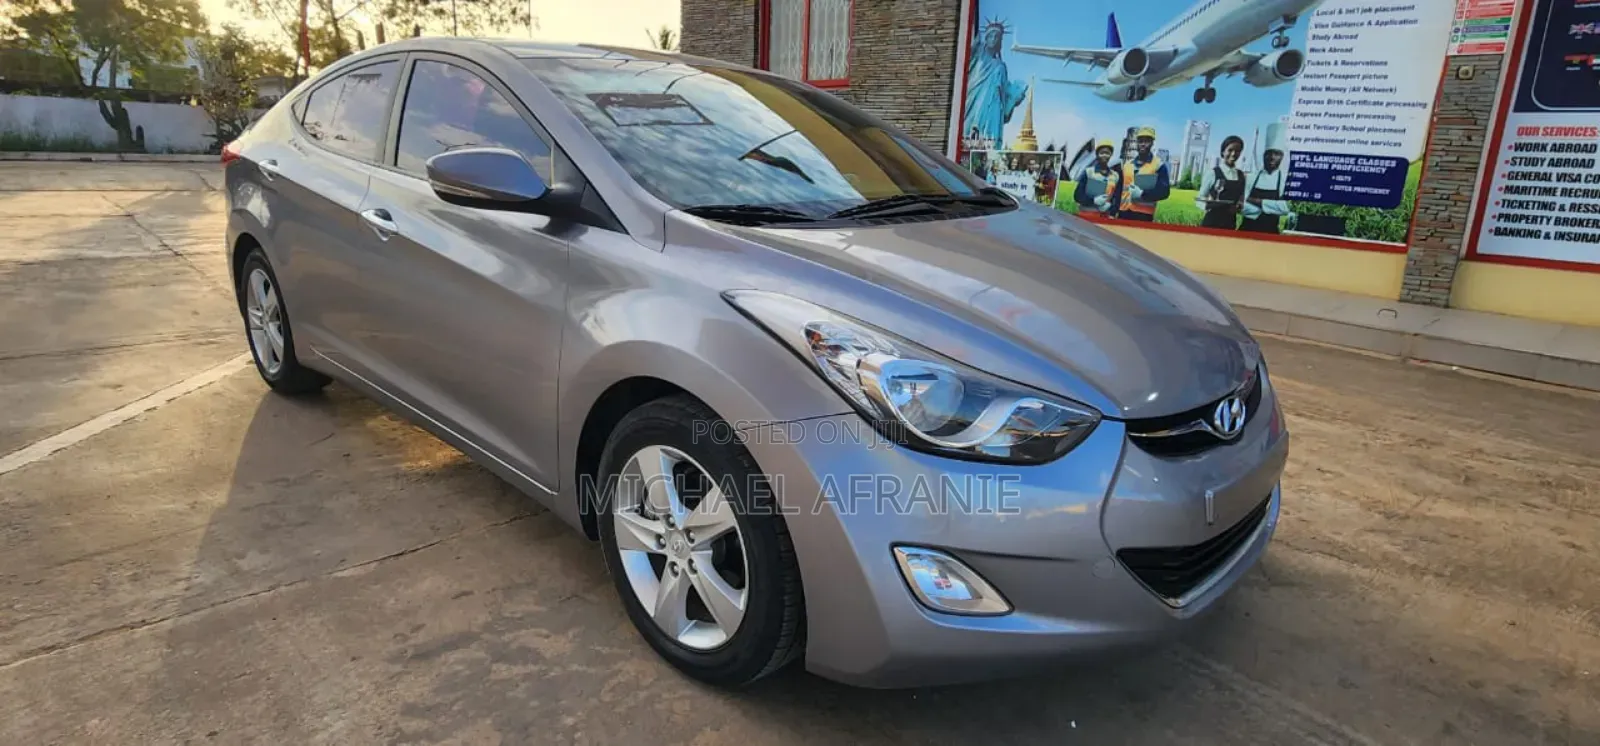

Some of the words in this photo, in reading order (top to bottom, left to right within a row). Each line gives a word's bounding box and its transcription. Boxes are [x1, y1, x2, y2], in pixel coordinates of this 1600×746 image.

[1375, 4, 1415, 14] placement
[1374, 18, 1419, 27] Application
[1329, 73, 1360, 81] Passport
[1298, 98, 1325, 106] Express
[1385, 101, 1428, 109] processing
[1323, 112, 1355, 120] Passport
[1356, 113, 1396, 121] processing
[1313, 124, 1340, 132] Tertiary
[1516, 126, 1540, 137] OUR
[1541, 126, 1597, 137] SERVICES
[1304, 136, 1346, 144] professional
[1513, 142, 1549, 152] WORK
[1549, 143, 1598, 154] ABROAD
[1313, 155, 1356, 165] LANGUAGE
[1357, 158, 1397, 167] CLASSES
[1509, 156, 1547, 167] STUDY
[1547, 158, 1595, 169] ABROAD
[1294, 161, 1329, 170] ENGLISH
[1330, 163, 1387, 174] PROFICIENCY
[1507, 171, 1553, 181] GENERAL
[1555, 172, 1582, 184] VISA
[1503, 185, 1558, 197] MARITIME
[1501, 199, 1557, 212] TICKETING
[1558, 203, 1566, 212] &
[1497, 213, 1552, 225] PROPERTY
[1493, 226, 1542, 240] BANKING
[1543, 231, 1551, 240] &
